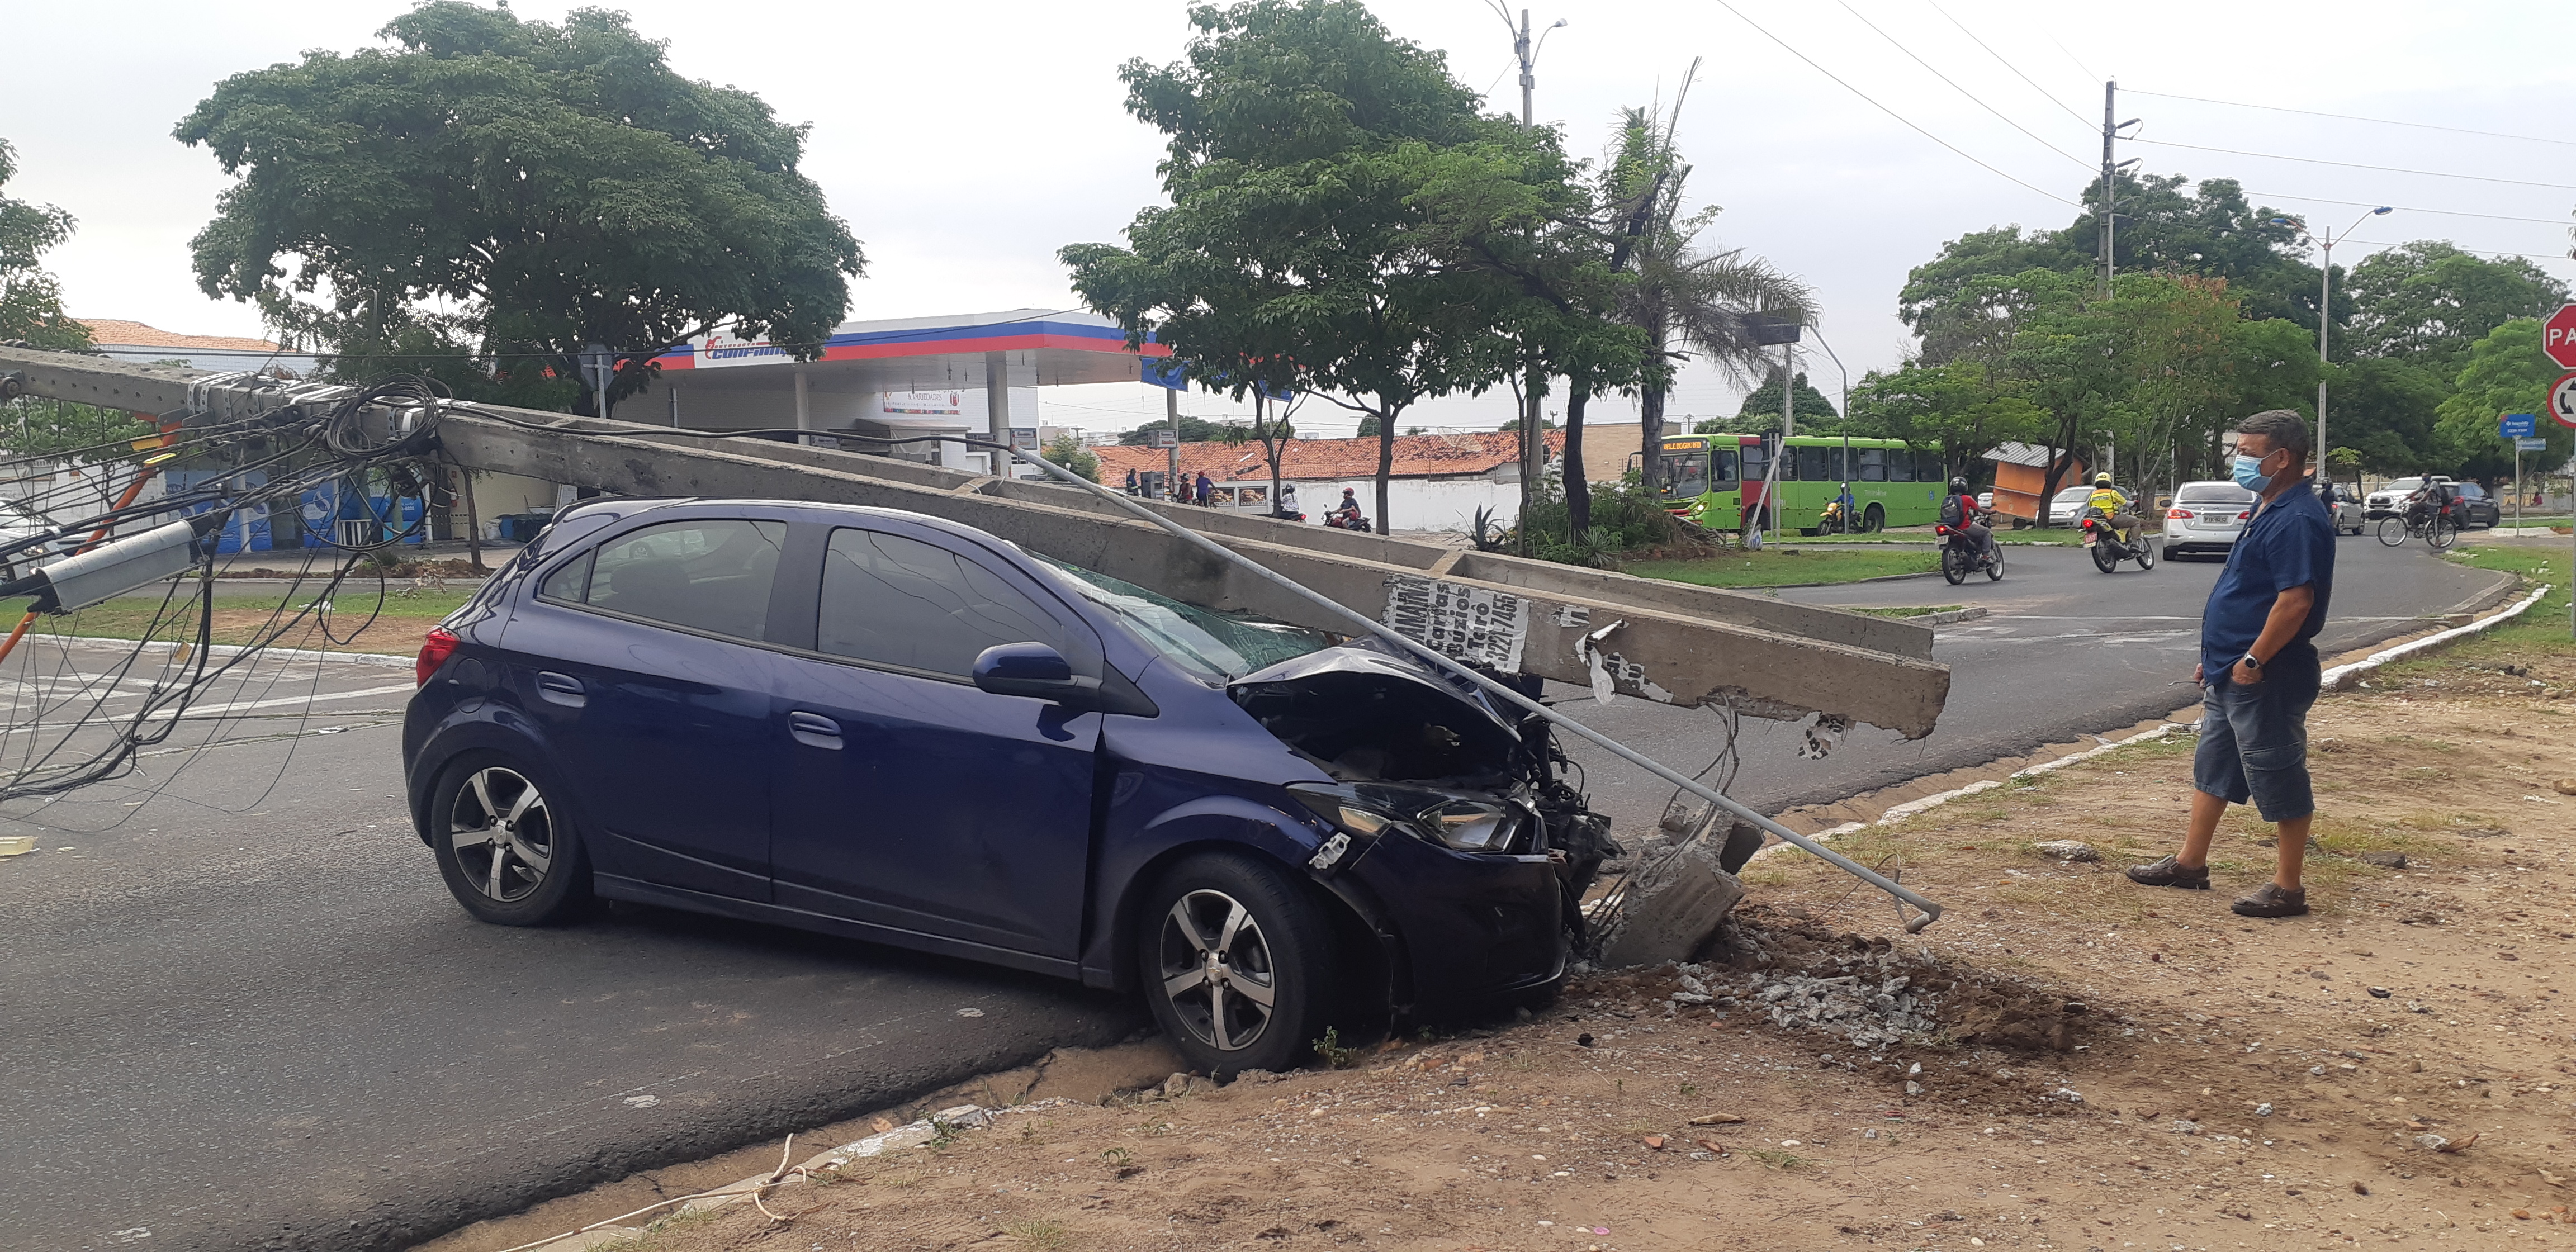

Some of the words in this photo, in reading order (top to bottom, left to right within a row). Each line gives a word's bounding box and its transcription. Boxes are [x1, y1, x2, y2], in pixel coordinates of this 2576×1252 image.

[1447, 586, 1471, 657] Búzios
[1467, 603, 1490, 649] Tarô
[1485, 593, 1518, 662] 3221-7455
